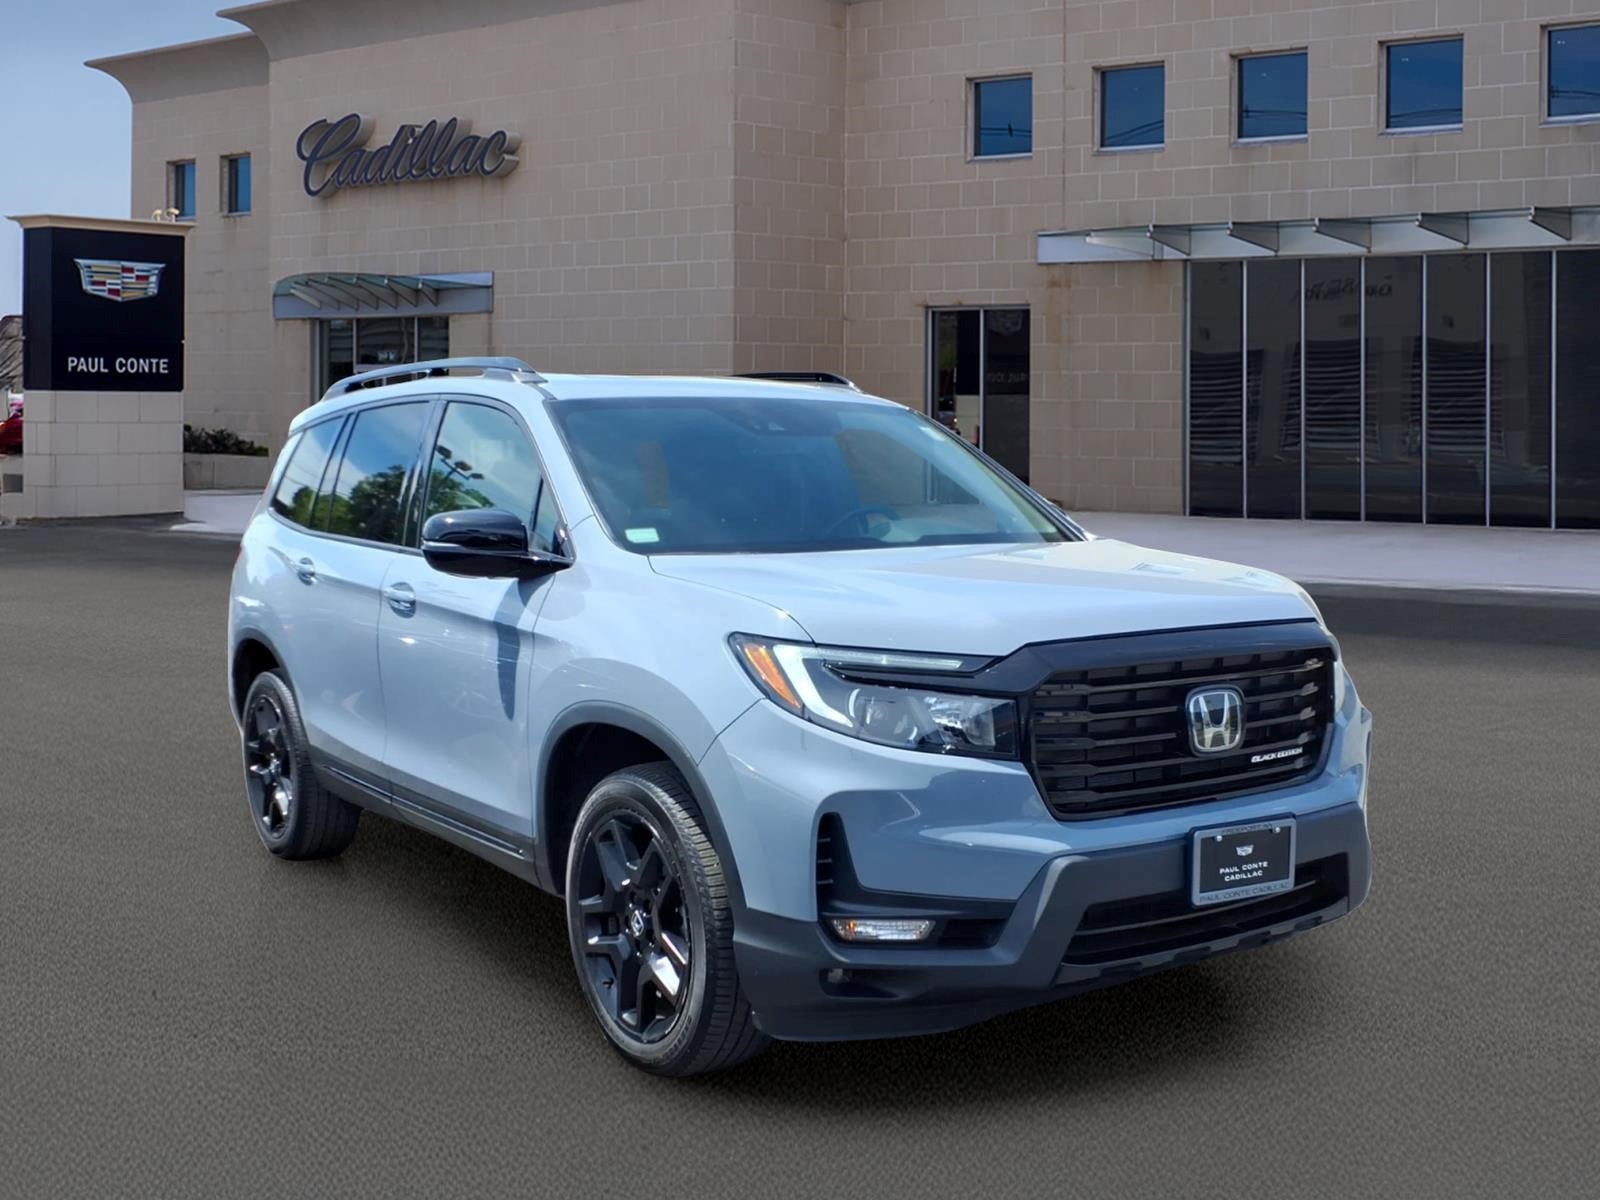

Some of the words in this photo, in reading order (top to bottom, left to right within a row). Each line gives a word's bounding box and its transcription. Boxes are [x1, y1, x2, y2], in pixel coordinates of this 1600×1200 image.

[296, 112, 514, 197] Cadillac
[68, 356, 109, 373] PAUL
[115, 357, 169, 374] CONTE
[1219, 866, 1240, 874] PAUL
[1241, 861, 1268, 871] CONTE
[1224, 870, 1263, 882] CADILLAC
